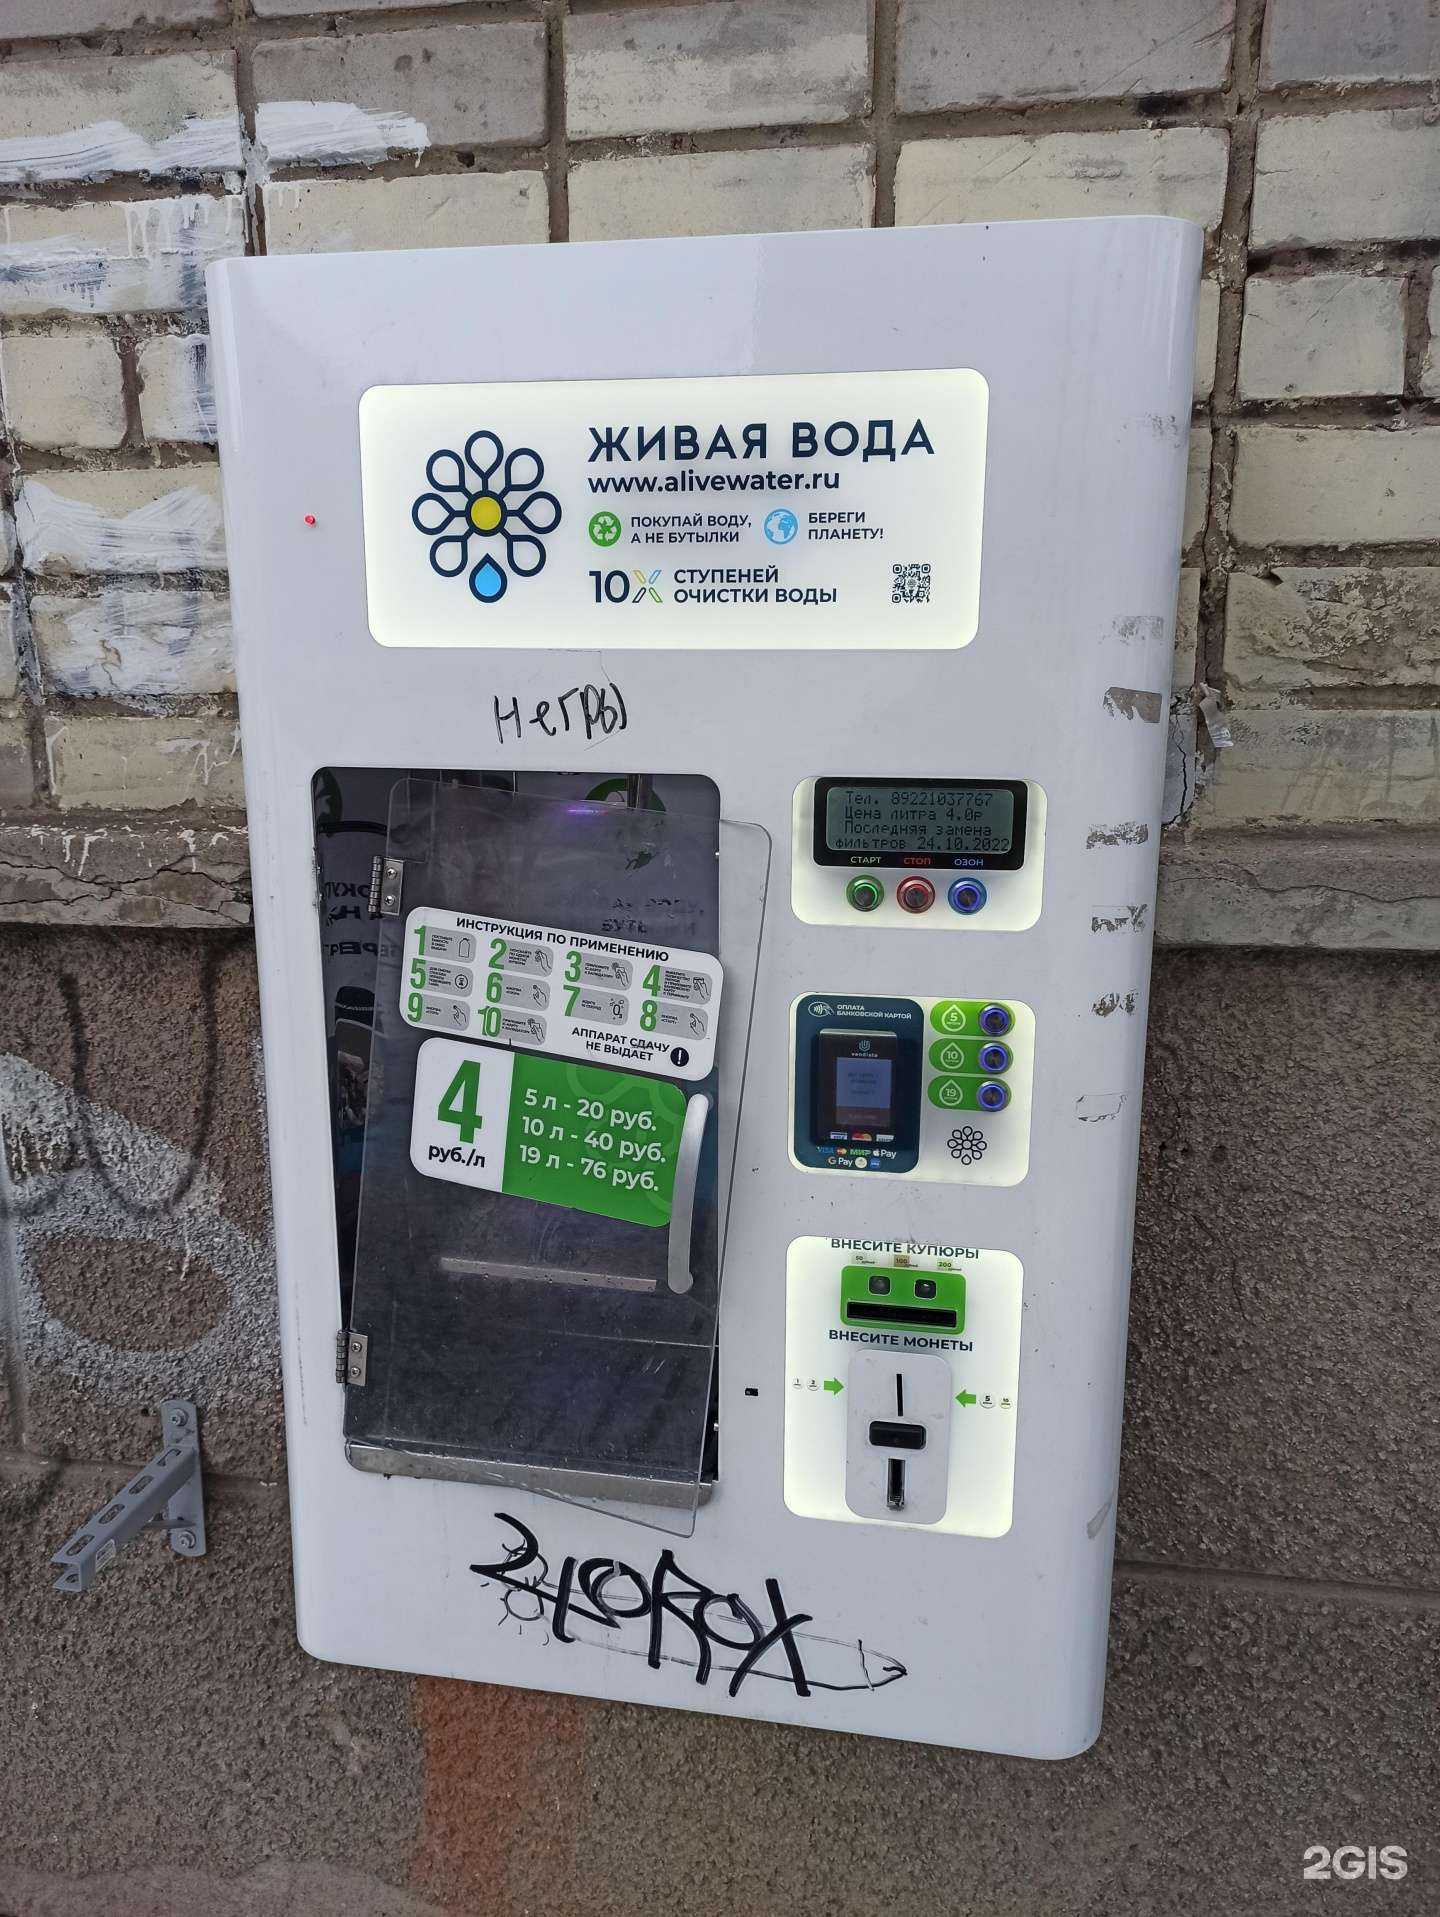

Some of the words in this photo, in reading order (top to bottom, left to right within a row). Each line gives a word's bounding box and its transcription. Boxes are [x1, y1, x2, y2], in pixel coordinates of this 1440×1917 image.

[587, 423, 768, 463] ЖИВАЯ
[791, 418, 936, 462] ВОДА
[588, 469, 841, 494] www.alivewater.ru
[630, 512, 703, 529] ПОКУПАЙ
[707, 513, 753, 530] ВОДУ,
[808, 511, 867, 525] БЕРЕГИ
[630, 533, 641, 545] А
[645, 533, 666, 544] НЕ
[669, 531, 740, 544] БУТЫЛКИ
[808, 526, 885, 542] ПЛАНЕТУ!
[673, 565, 780, 585] СТУПЕНЕЙ
[673, 587, 771, 606] ОЧИСТКИ
[775, 587, 838, 604] ВОДЫ
[845, 791, 880, 806] Тел.
[891, 791, 993, 807] 89221037767
[844, 807, 882, 821] Цена
[891, 808, 937, 821] литра
[844, 820, 927, 836] Последняя
[936, 824, 993, 837] замена
[835, 836, 907, 850] фильтров
[917, 837, 1010, 852] 24.10.2022
[850, 856, 882, 865] СТАРТ
[903, 857, 931, 866] СТОП
[954, 858, 984, 867] ОЗОН
[414, 925, 426, 956] 1
[456, 917, 543, 941] ИНСТРУКЦИЯ
[547, 932, 567, 944] ПО
[570, 936, 669, 962] ПРИМЕНЕНИЮ
[488, 938, 508, 970] 2
[410, 958, 426, 989] 5
[564, 950, 582, 982] 3
[486, 972, 503, 1003] 6
[642, 964, 661, 997] 4
[407, 992, 423, 1023] 9
[563, 985, 581, 1017] 7
[478, 1006, 501, 1038] 10
[640, 1000, 658, 1032] 8
[837, 1010, 883, 1018] БАНКОВСКОЙ
[884, 1012, 912, 1020] КАРТОЙ
[950, 1012, 958, 1022] 5
[572, 1027, 627, 1044] АППАРАТ
[630, 1037, 670, 1053] СДАЧУ
[586, 1041, 601, 1052] НЕ
[604, 1044, 653, 1062] ВЫДАЕТ
[946, 1051, 958, 1060] 10
[437, 1059, 483, 1144] 4
[945, 1088, 957, 1097] 19
[524, 1088, 538, 1106] 5
[542, 1096, 557, 1110] л
[576, 1099, 604, 1120] 20
[609, 1108, 657, 1131] руб.
[521, 1116, 545, 1136] 10
[549, 1126, 564, 1141] л
[584, 1130, 613, 1151] 40
[619, 1139, 666, 1163] руб.
[428, 1144, 486, 1168] руб./л
[838, 1157, 853, 1167] Pay
[880, 1149, 897, 1159] Pay
[519, 1144, 541, 1164] 19
[545, 1154, 561, 1169] л
[580, 1158, 607, 1179] 76
[612, 1168, 659, 1191] руб.
[831, 1238, 903, 1253] ВНЕСИТЕ
[907, 1243, 979, 1259] КУПЮРЫ
[829, 1330, 899, 1345] ВНЕСИТЕ
[904, 1336, 974, 1351] МОНЕТЫ
